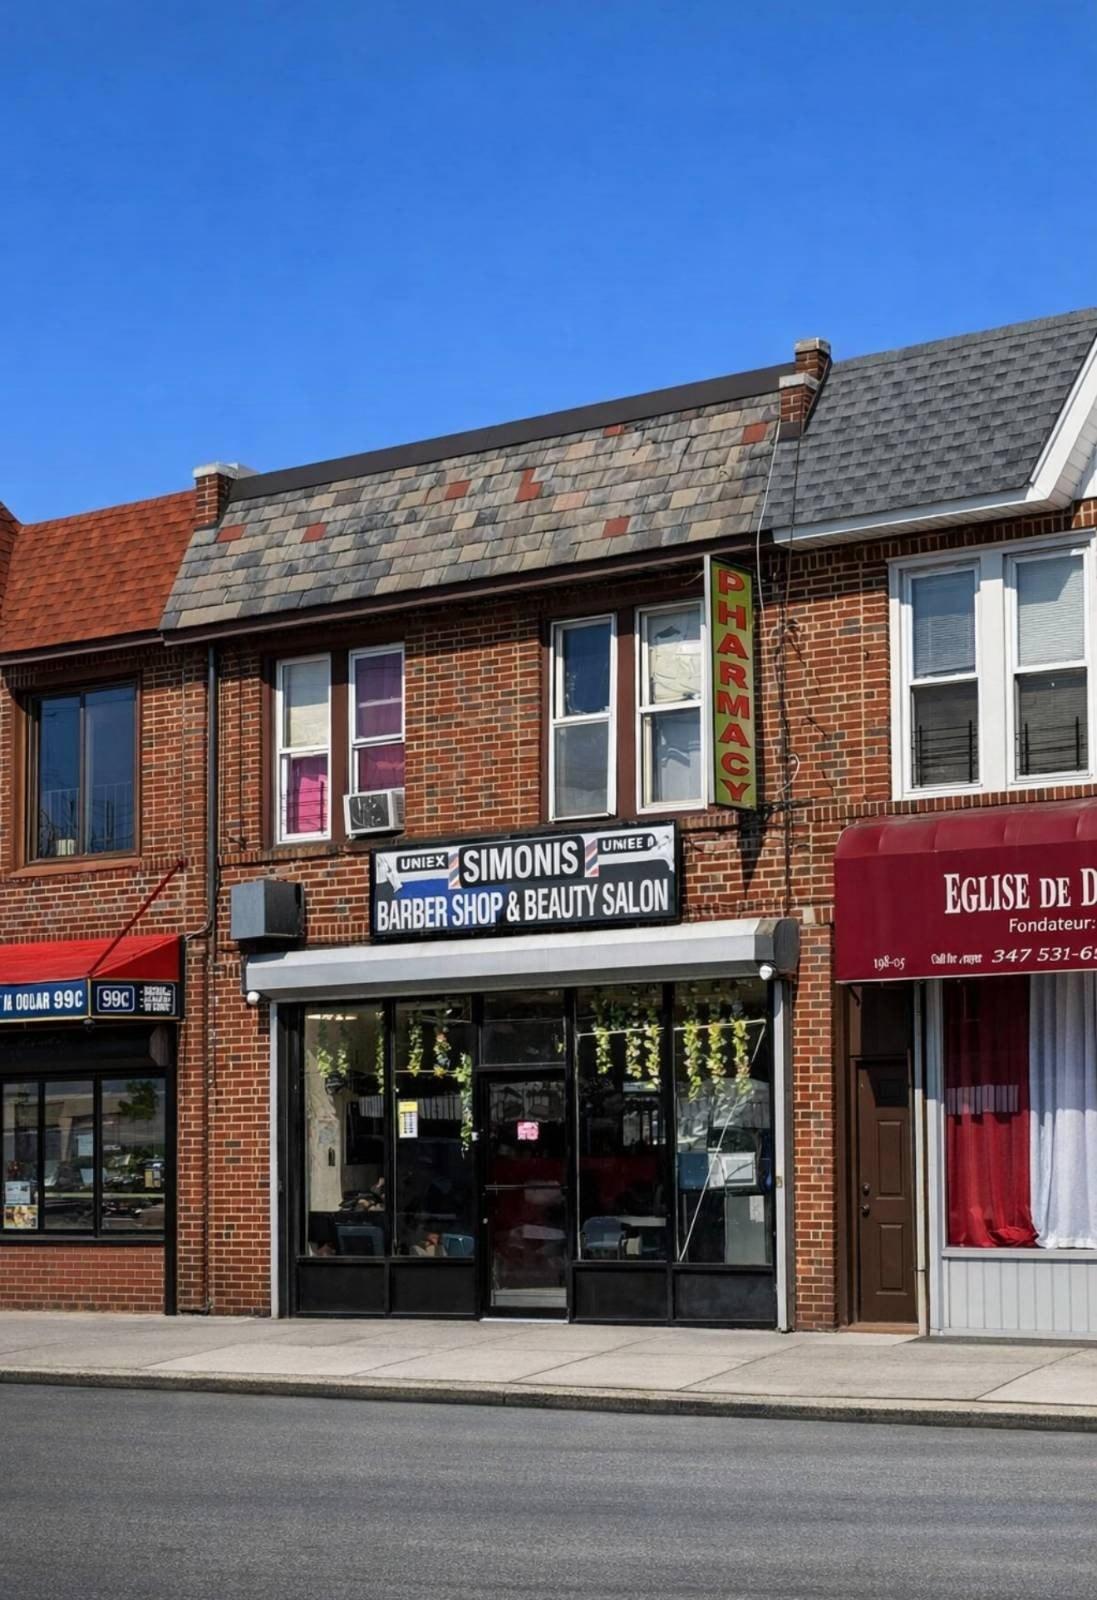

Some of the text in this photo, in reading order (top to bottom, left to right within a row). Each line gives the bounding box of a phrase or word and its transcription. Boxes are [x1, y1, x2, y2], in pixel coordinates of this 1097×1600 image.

[717, 568, 751, 801] PHARMACY
[401, 853, 446, 870] UNIEX
[463, 840, 579, 882] SIMONIS
[377, 878, 669, 932] BARBER SHOP & BEAUTY SALON
[944, 873, 1030, 914] EGLISE
[1039, 877, 1071, 908] DE
[1009, 917, 1096, 933] Fondateur:
[874, 955, 905, 971] 198-05
[992, 948, 1032, 963] 347
